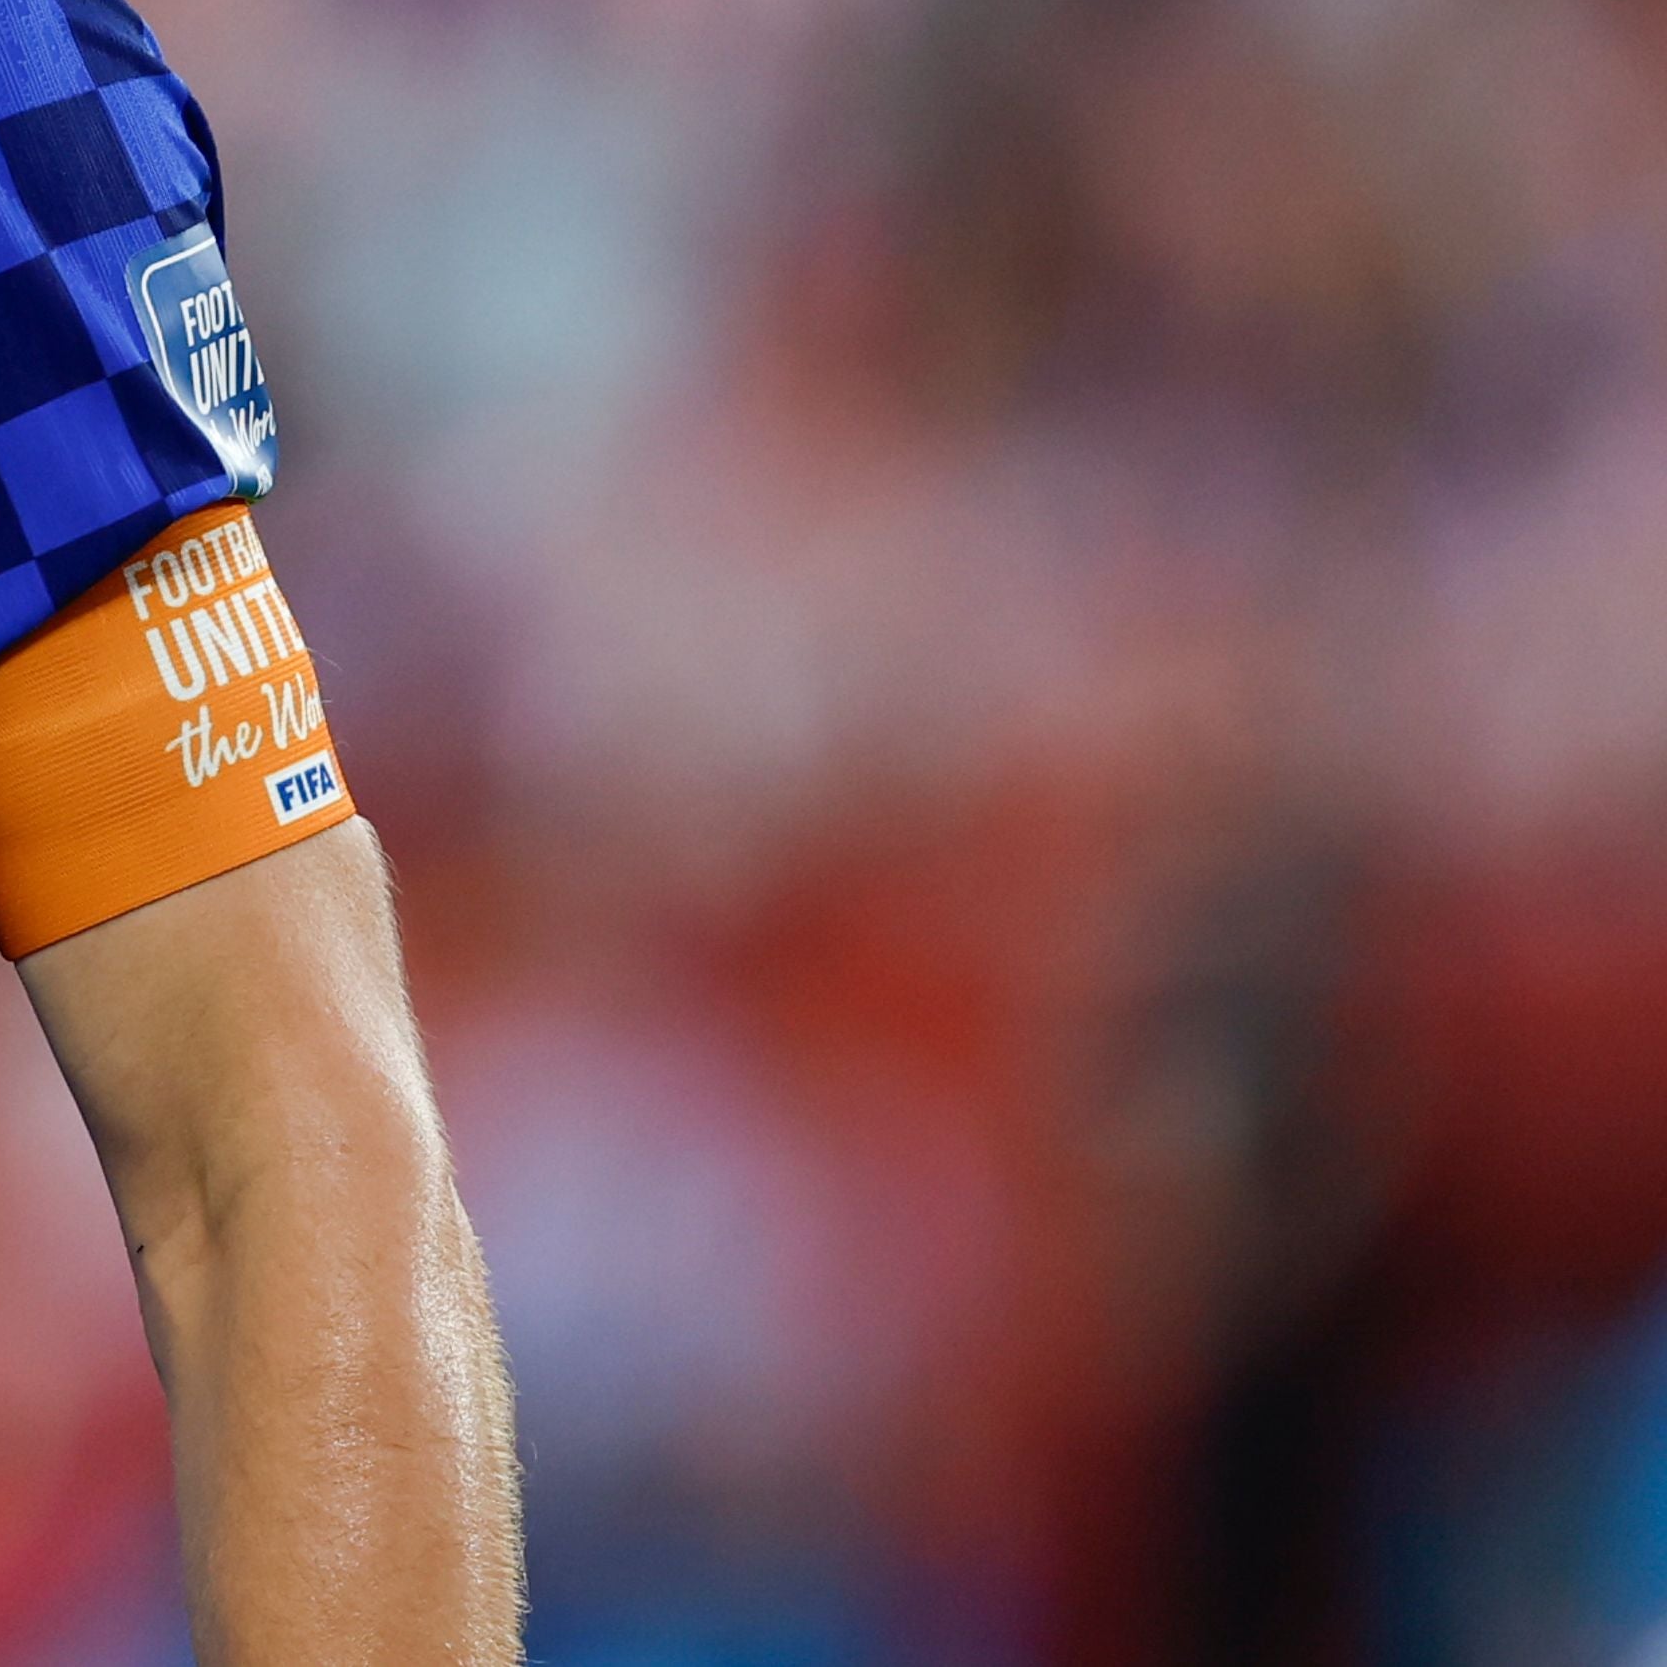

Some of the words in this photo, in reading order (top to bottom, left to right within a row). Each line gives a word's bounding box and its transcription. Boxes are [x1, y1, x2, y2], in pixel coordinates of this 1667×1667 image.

[180, 279, 245, 347] FOOT
[190, 327, 265, 415] UNIT
[165, 705, 263, 788] the
[276, 762, 336, 813] FIFA
